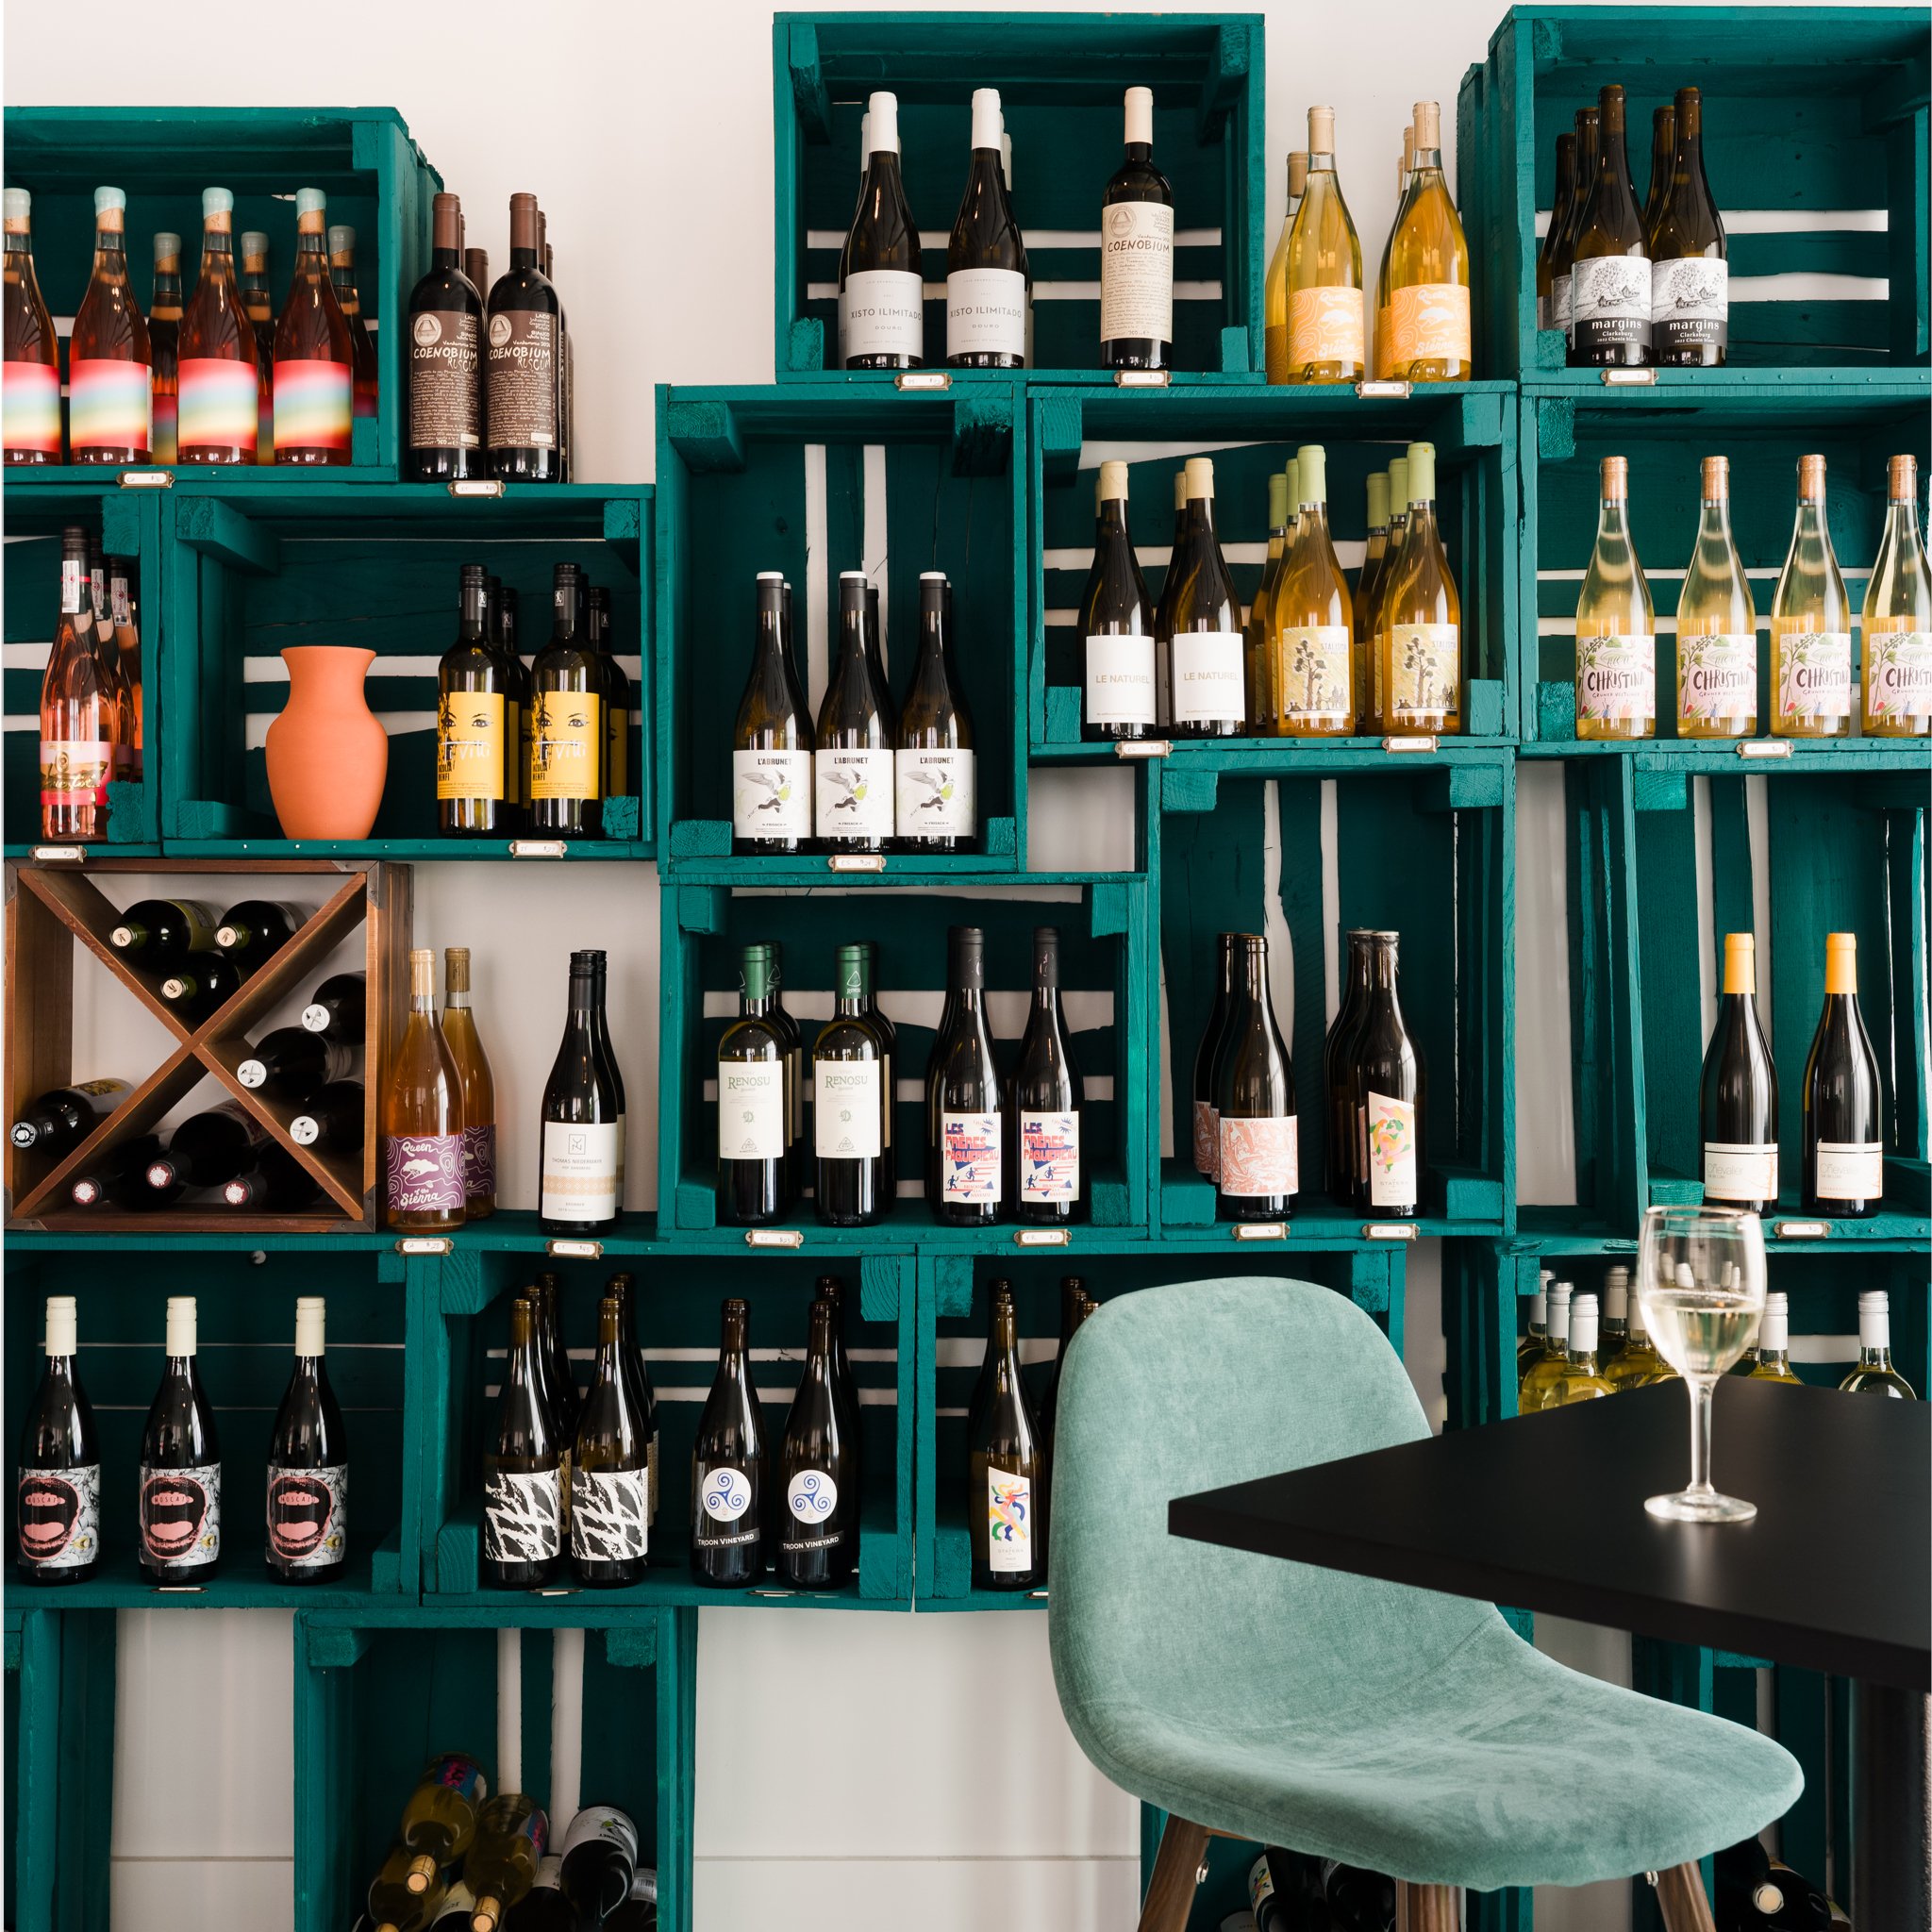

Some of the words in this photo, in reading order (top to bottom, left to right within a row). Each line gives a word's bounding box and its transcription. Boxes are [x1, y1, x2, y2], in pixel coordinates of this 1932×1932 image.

[1108, 240, 1170, 253] COENOBIUM
[851, 308, 875, 319] XISTO
[878, 308, 922, 321] ILIMITADO
[950, 308, 973, 318] XISTO
[975, 307, 1022, 318] ILIMITADO
[1591, 318, 1642, 331] margins
[1670, 319, 1720, 332] margins
[413, 346, 478, 360] COENOBIUM
[489, 346, 551, 360] COENOBIUM
[1095, 675, 1108, 684] LE
[1109, 674, 1151, 685] NATUREL
[1184, 672, 1196, 681] LE
[1198, 672, 1239, 681] NATUREL
[1587, 670, 1645, 692] CHRISTINA
[1885, 666, 1931, 688] CHRISTI
[727, 1075, 771, 1090] RENOSU
[824, 1075, 868, 1089] RENOSU
[945, 1123, 964, 1135] LES
[1023, 1122, 1042, 1134] LES
[402, 1141, 435, 1157] Queen
[400, 1191, 440, 1208] Sierra
[698, 1538, 719, 1547] TROON
[720, 1533, 755, 1545] VINEYARD
[783, 1542, 804, 1551] TROON
[805, 1536, 840, 1549] VINEYARD
